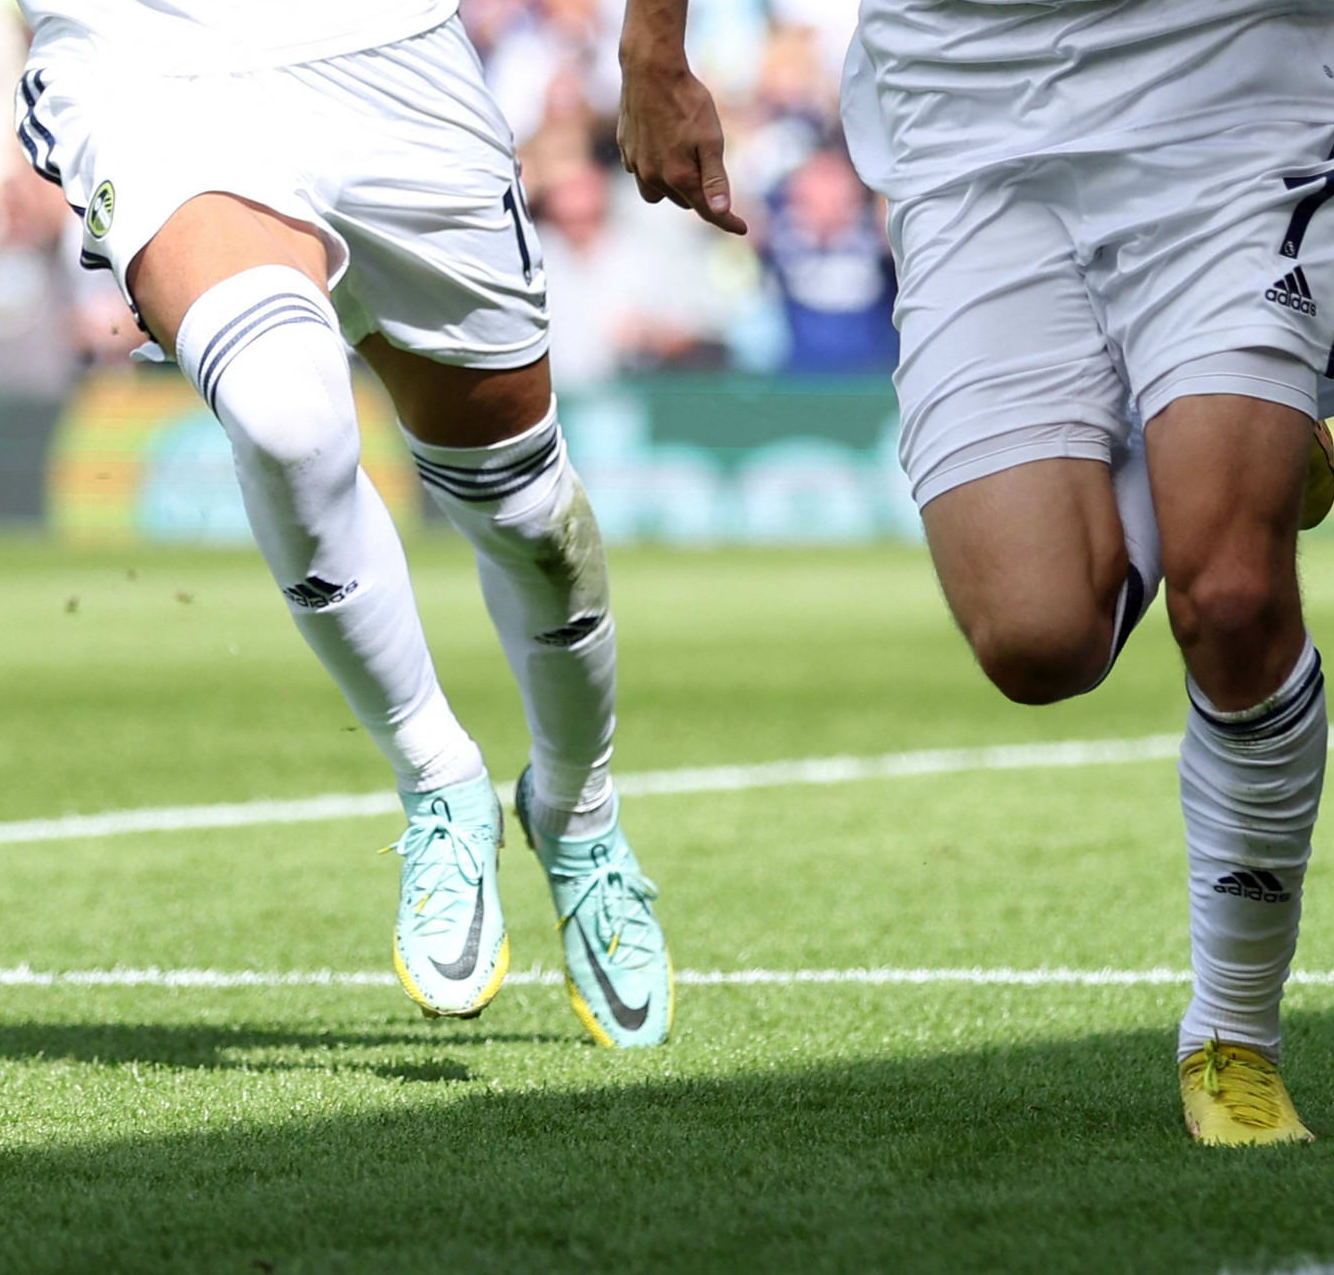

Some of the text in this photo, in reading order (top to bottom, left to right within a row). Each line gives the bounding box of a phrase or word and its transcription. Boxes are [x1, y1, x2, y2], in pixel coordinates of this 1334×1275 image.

[503, 185, 533, 286] 1
[1265, 288, 1317, 318] adidas
[1213, 882, 1291, 904] adidas
